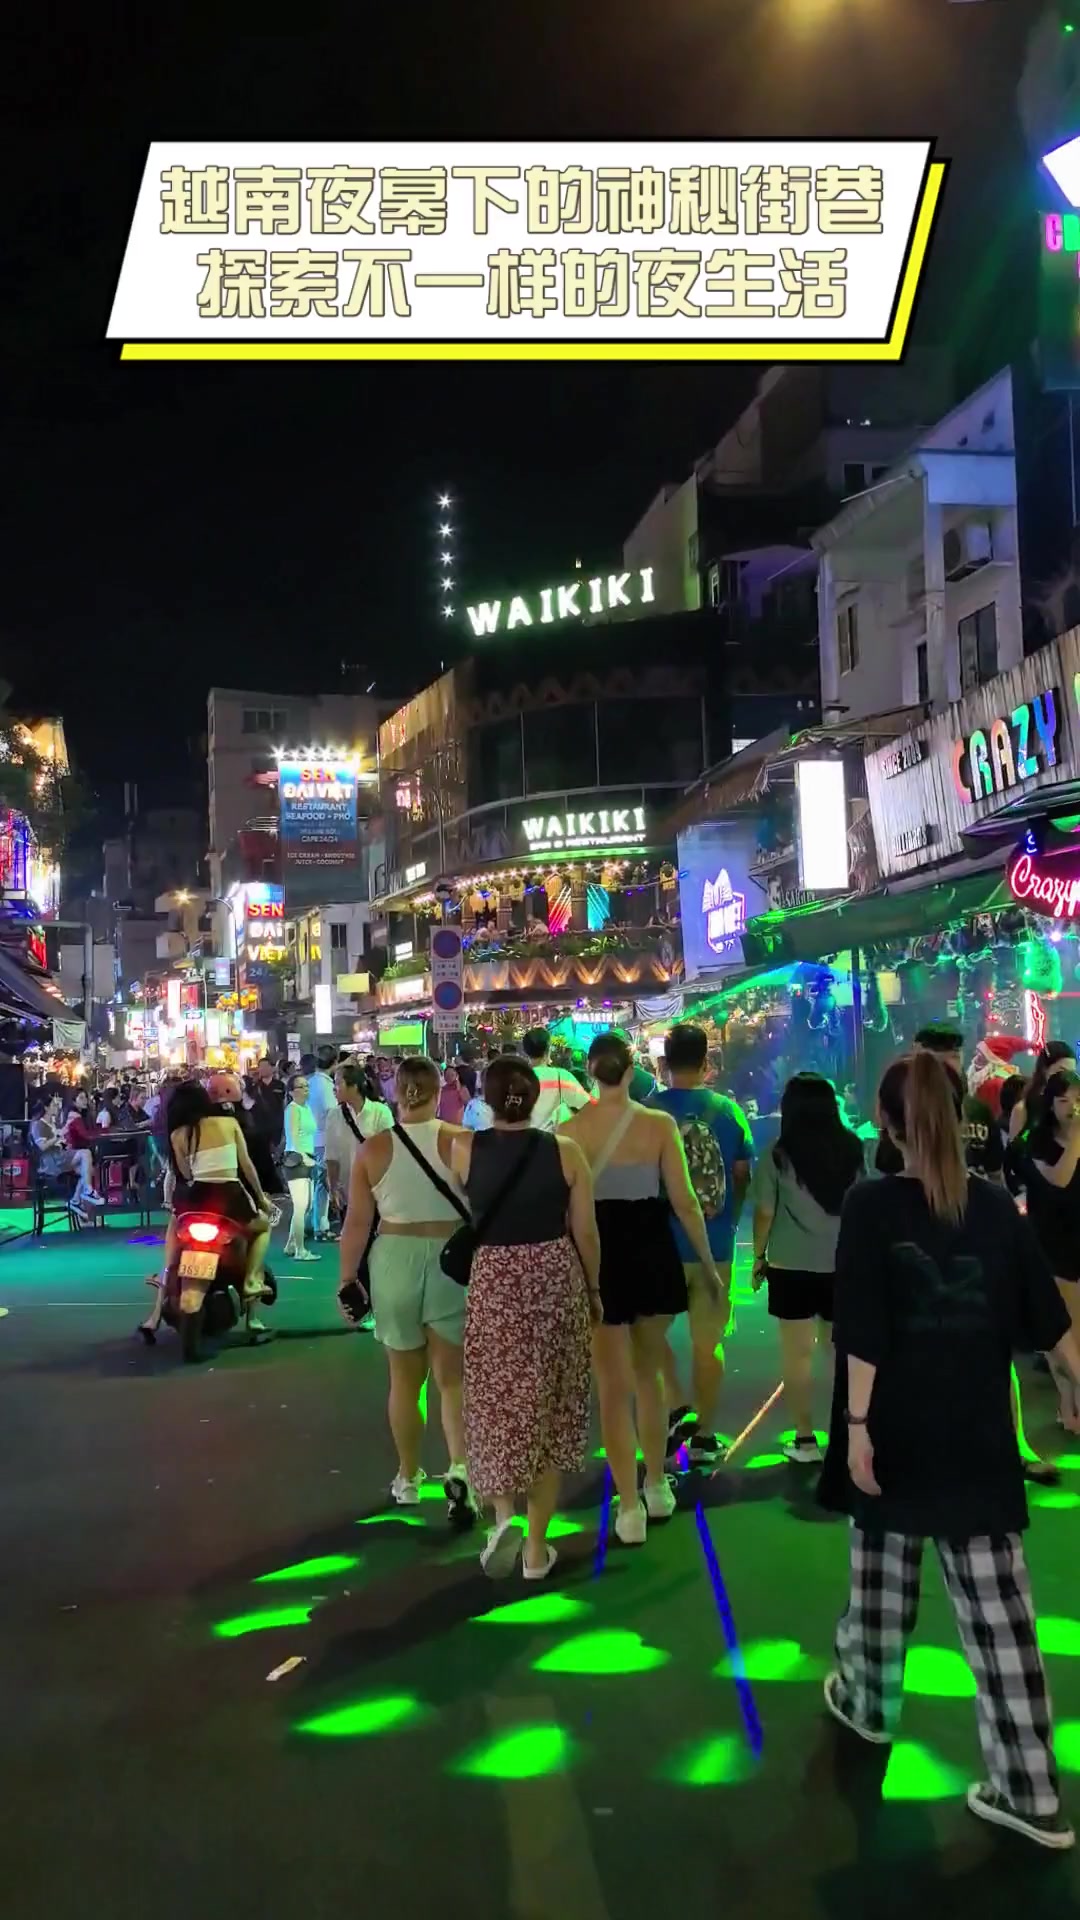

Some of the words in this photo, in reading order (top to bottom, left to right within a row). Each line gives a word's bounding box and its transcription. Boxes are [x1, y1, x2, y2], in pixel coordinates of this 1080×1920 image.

[466, 566, 655, 636] WAIKIKI
[953, 689, 1057, 803] CRAZY
[301, 768, 336, 782] SEN
[291, 803, 347, 811] RESTAURANT
[286, 812, 326, 820] SEAFOOD
[522, 807, 646, 840] WAIKIKI
[247, 903, 284, 917] SEN
